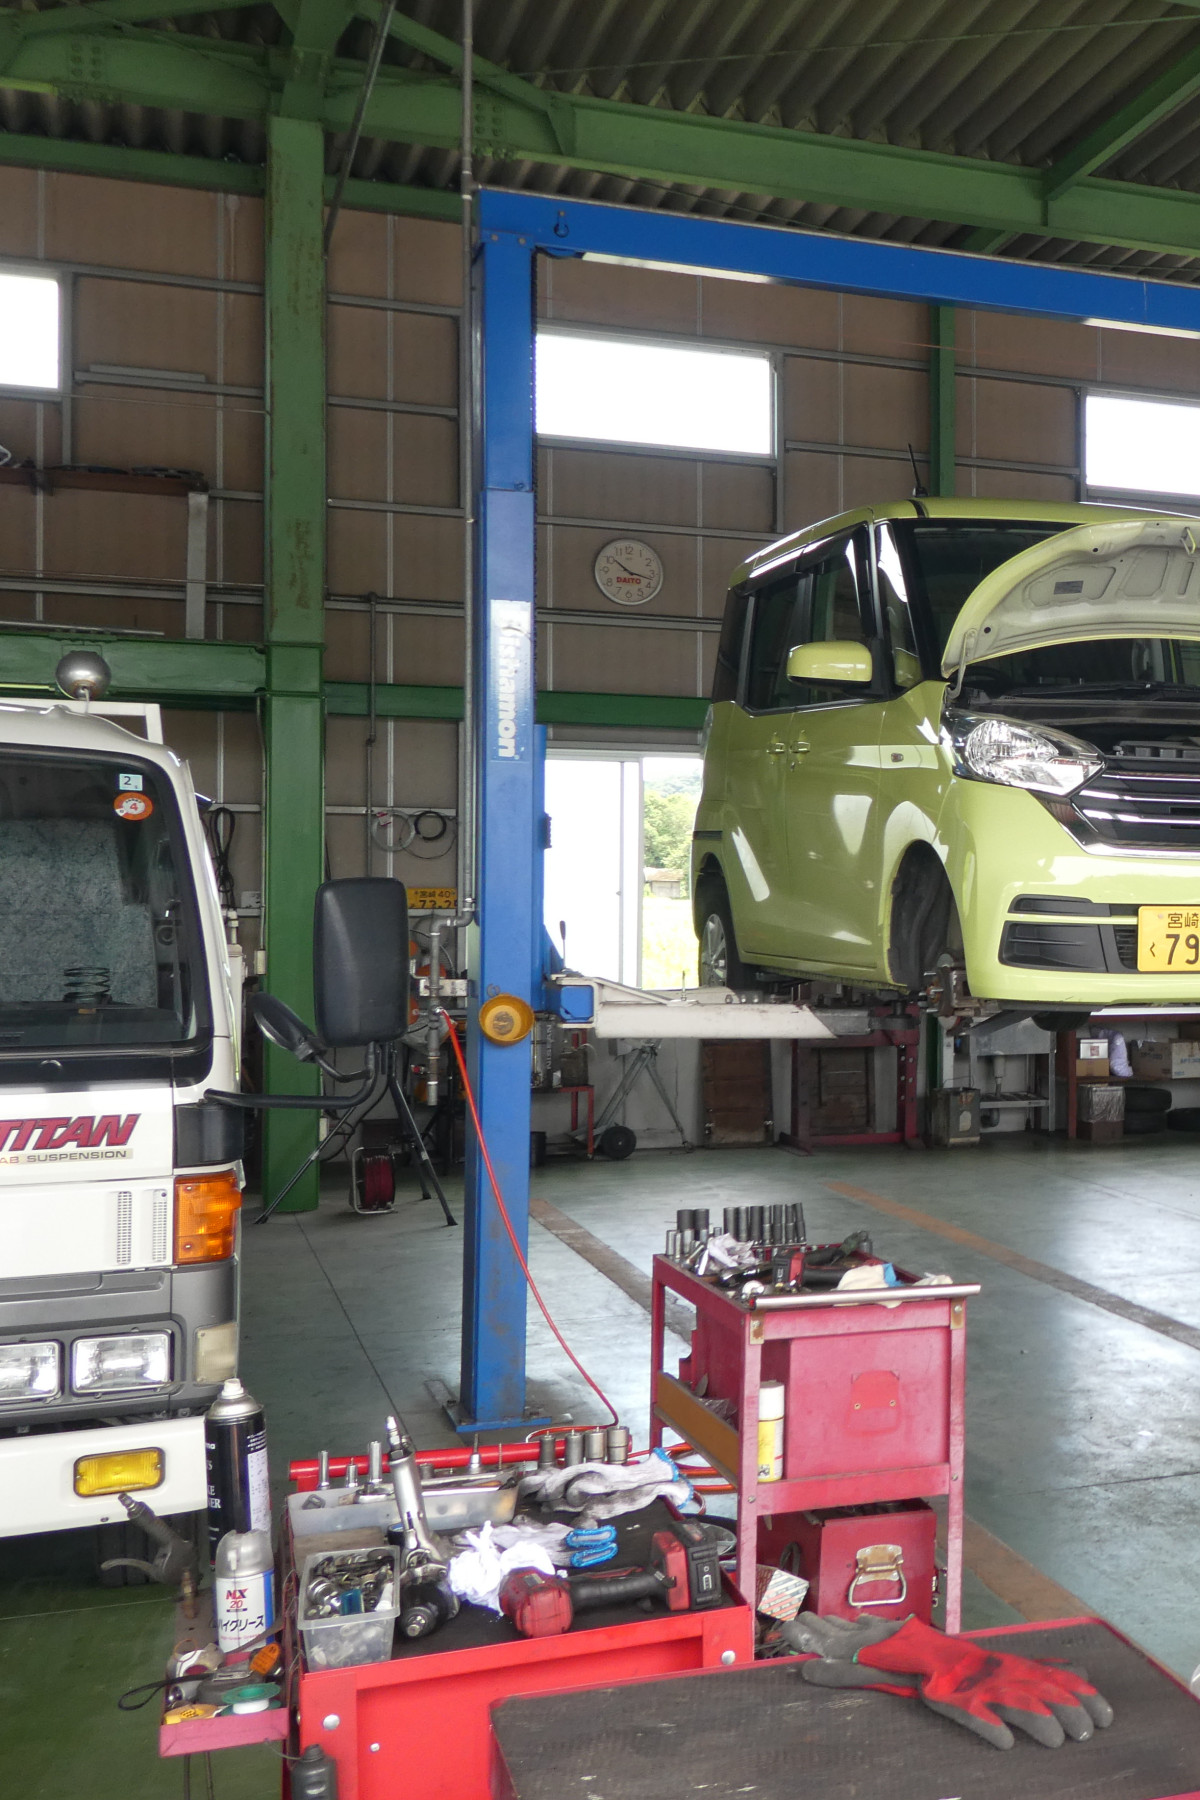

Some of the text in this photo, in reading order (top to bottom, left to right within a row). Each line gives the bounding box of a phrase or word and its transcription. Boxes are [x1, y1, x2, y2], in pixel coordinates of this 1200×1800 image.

[615, 546, 622, 556] 11
[625, 545, 634, 555] 12
[639, 549, 643, 558] 1
[606, 555, 615, 565] 10
[645, 558, 652, 567] 2
[602, 565, 609, 574] 9
[649, 569, 655, 579] 3
[606, 577, 613, 587] 8
[616, 576, 642, 585] DAITO
[645, 581, 652, 589] 4
[616, 586, 622, 595] 7
[625, 590, 632, 599] 6
[637, 588, 644, 597] 5
[123, 775, 132, 786] 2
[1149, 942, 1156, 957] く
[0, 1113, 142, 1151] TITAN
[27, 1150, 127, 1163] SUSPENSION
[230, 1599, 243, 1609] 20
